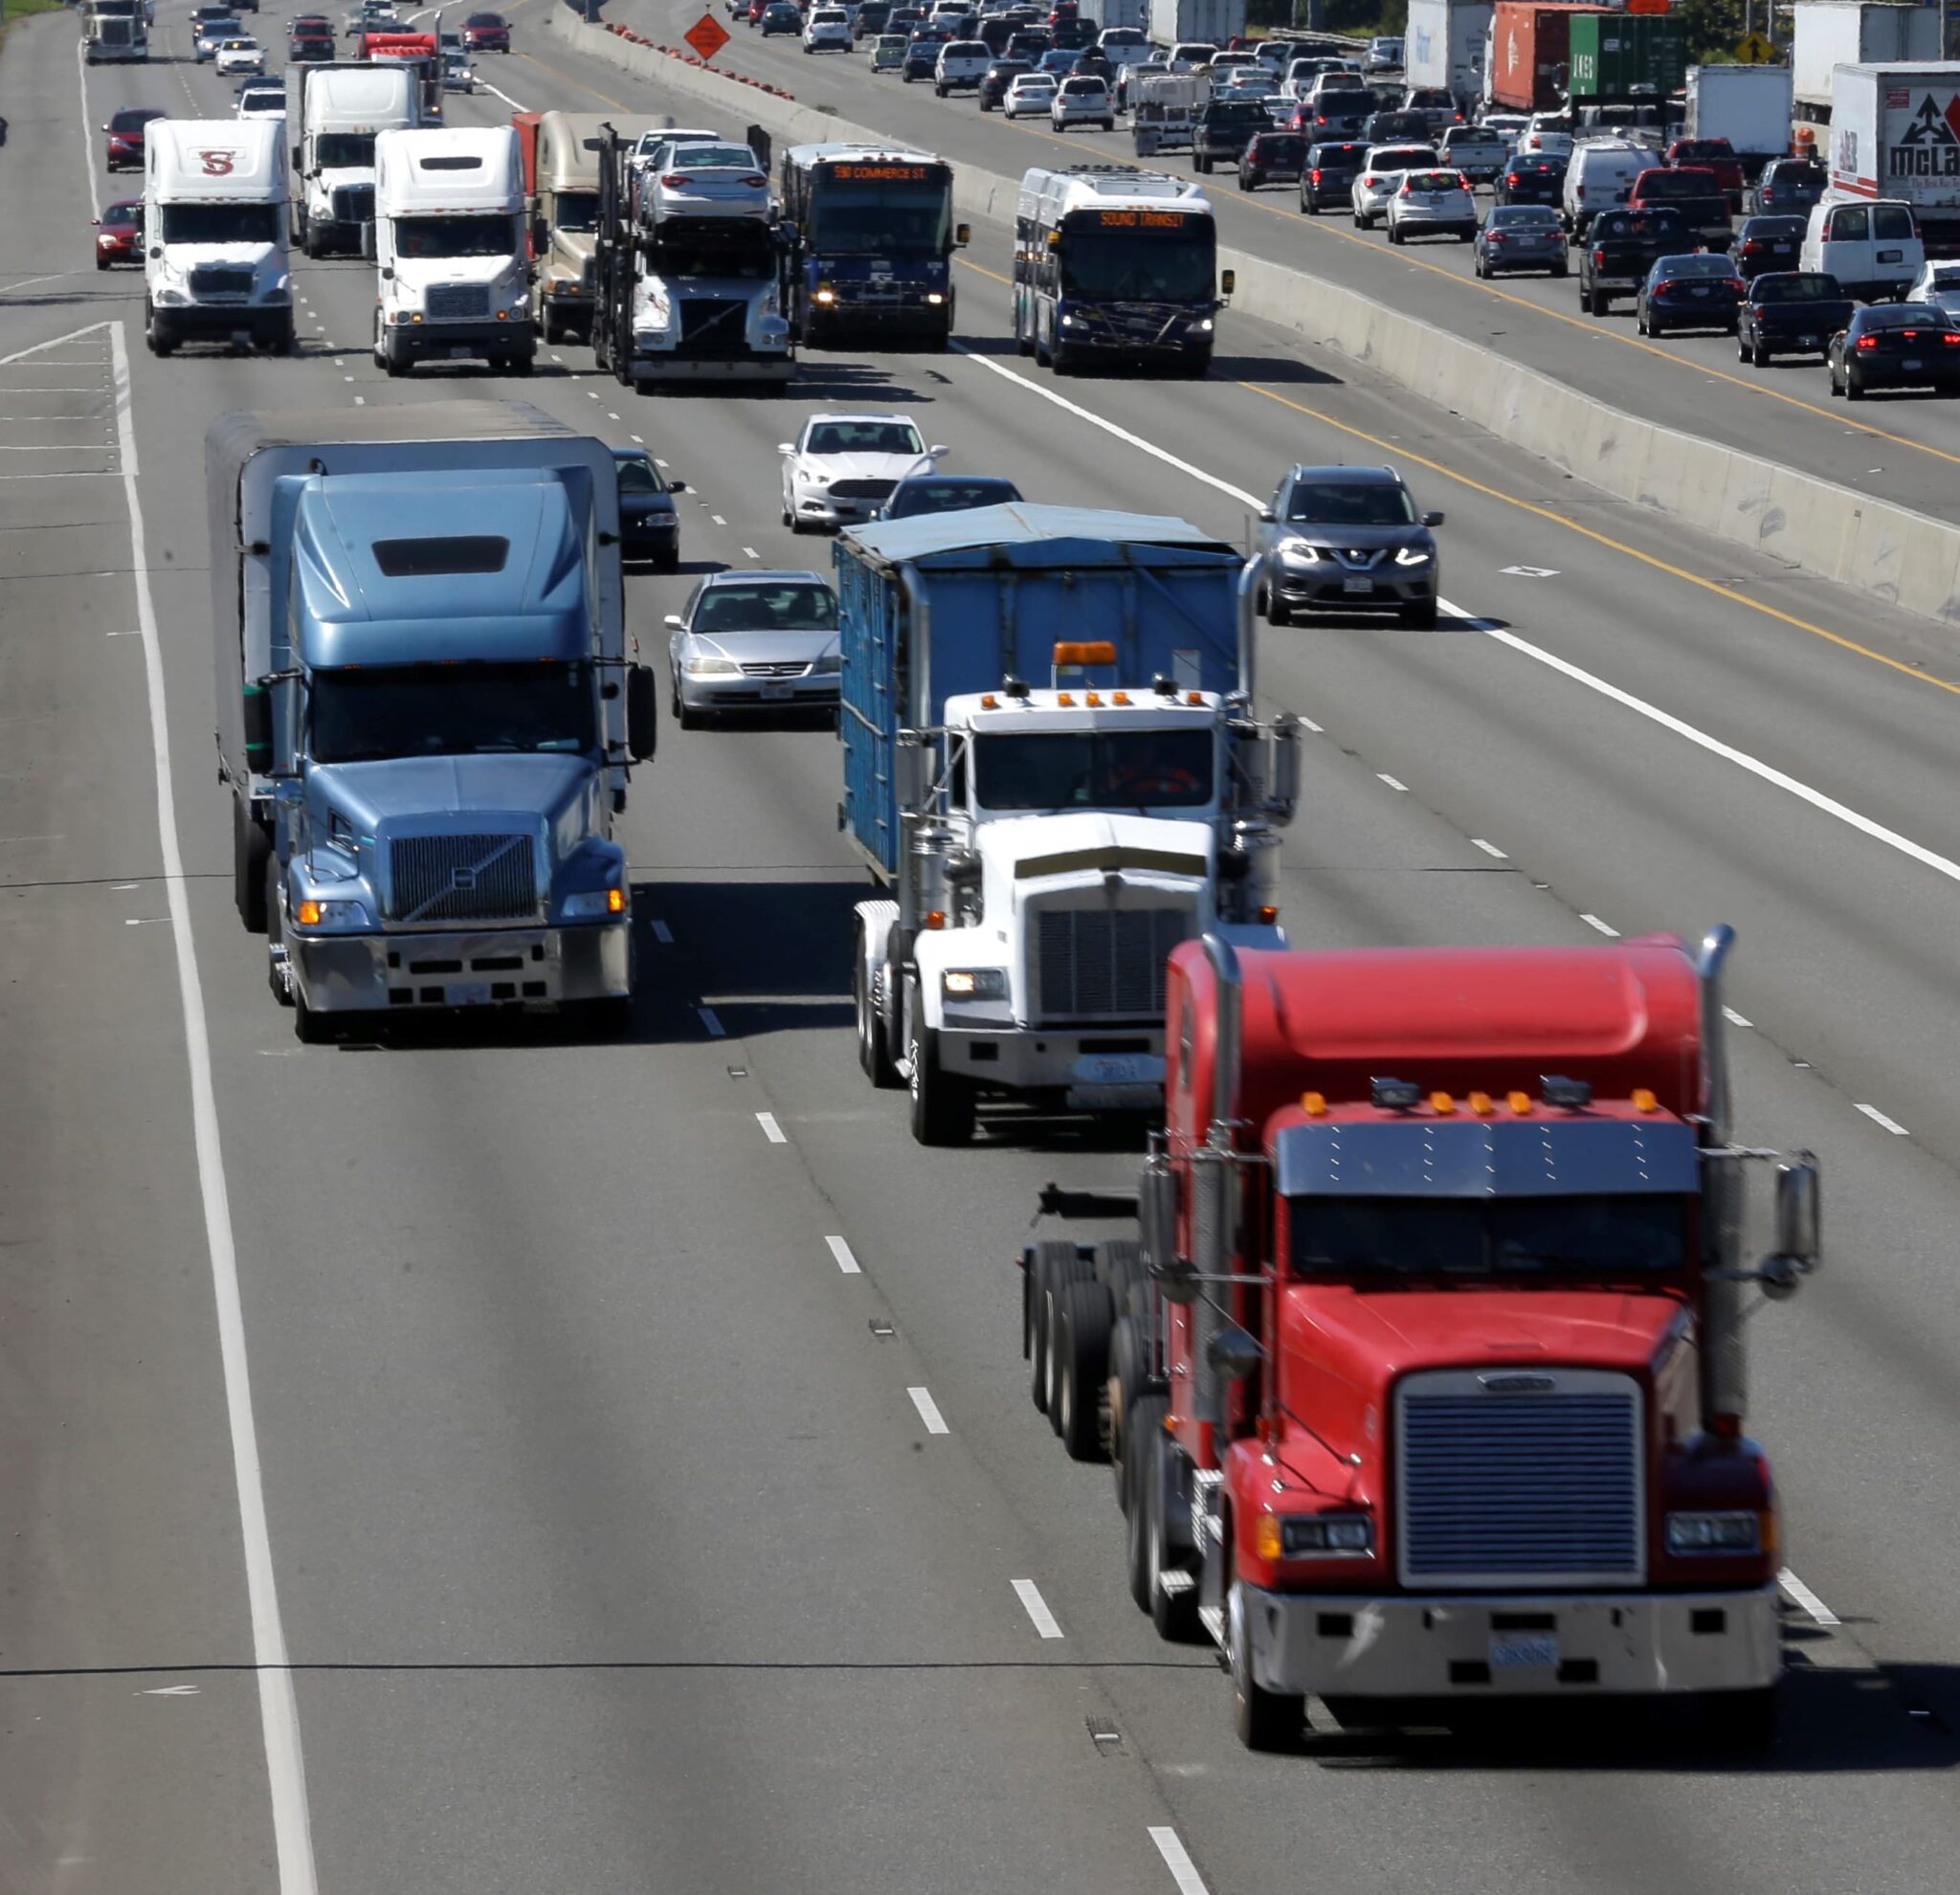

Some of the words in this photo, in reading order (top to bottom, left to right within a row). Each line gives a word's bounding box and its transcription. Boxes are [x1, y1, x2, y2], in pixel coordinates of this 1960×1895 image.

[853, 167, 910, 179] COMMERCE
[1101, 212, 1136, 226] SOUND
[1141, 212, 1184, 228] TRANSIT
